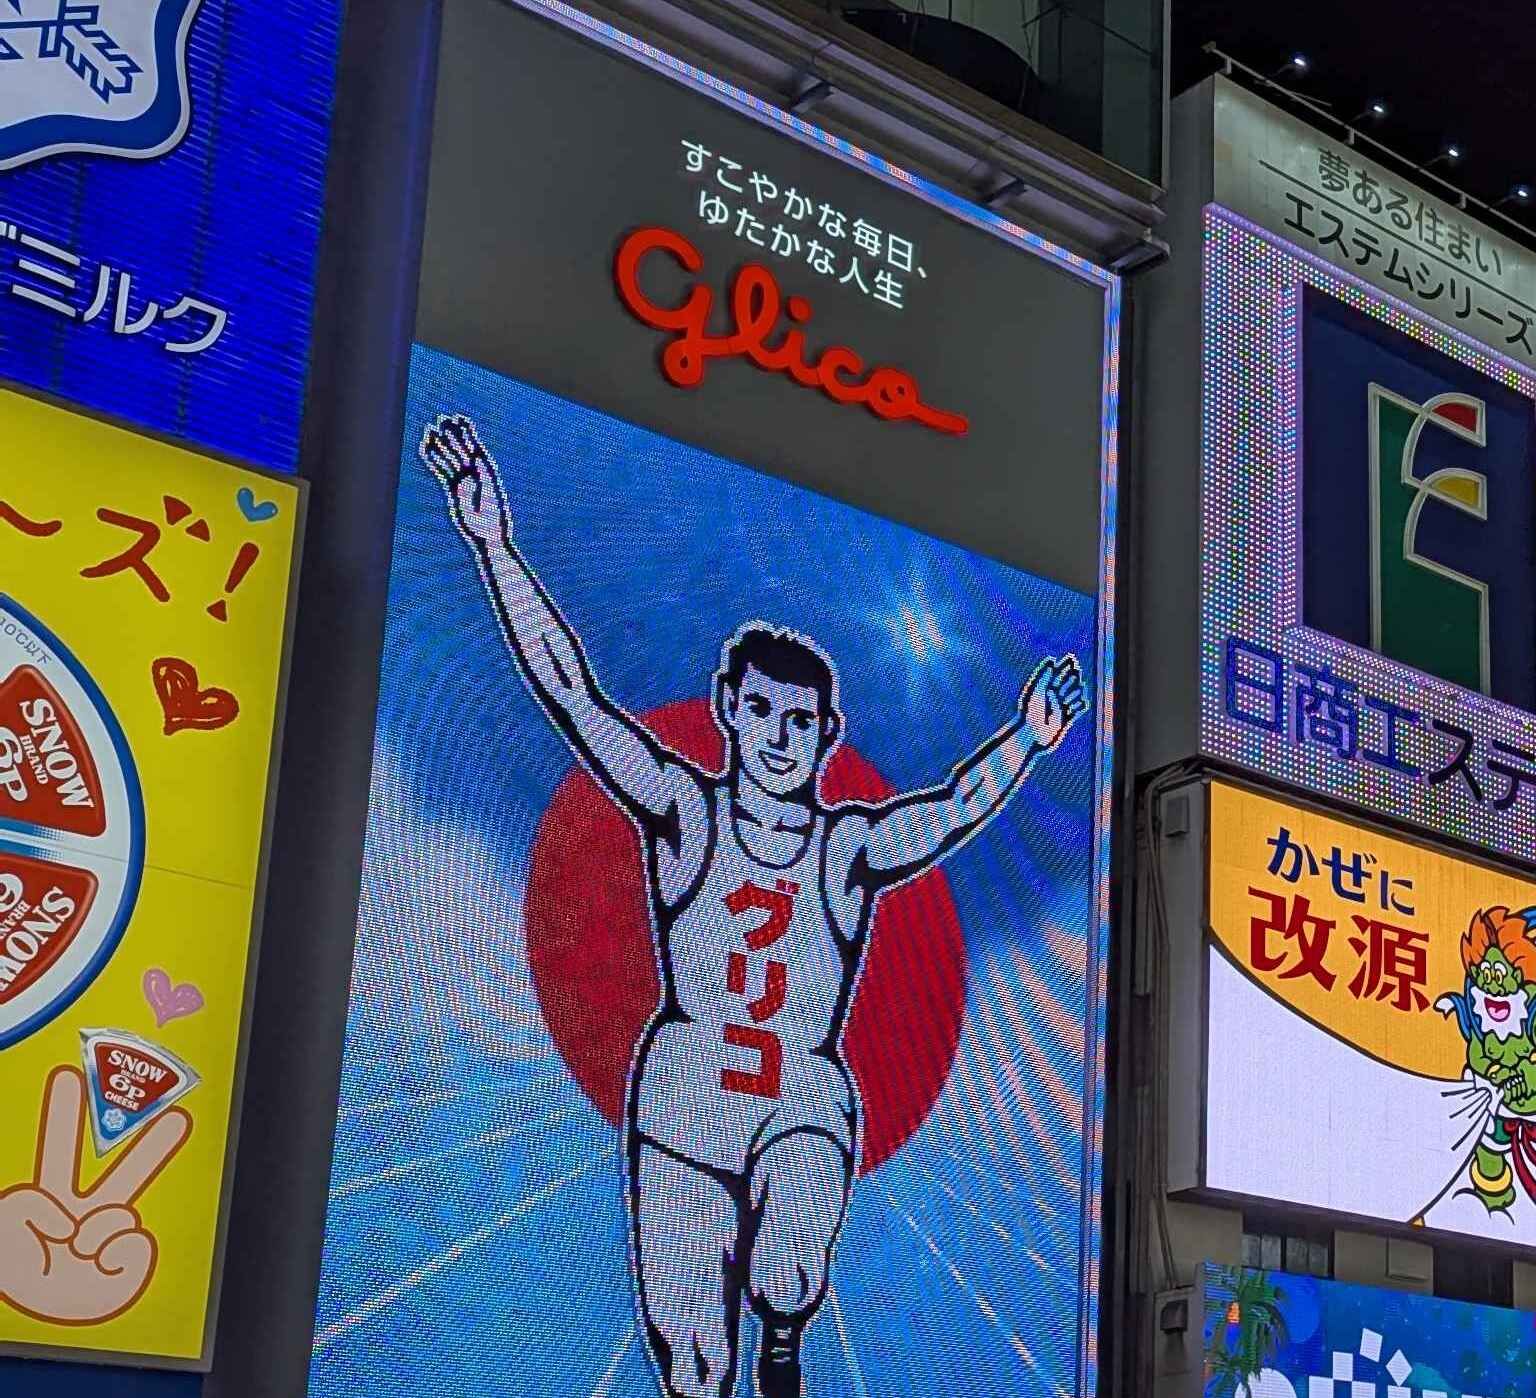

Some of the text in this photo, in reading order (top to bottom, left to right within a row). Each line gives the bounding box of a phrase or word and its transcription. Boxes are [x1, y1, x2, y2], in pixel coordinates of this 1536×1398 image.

[681, 140, 927, 278] すこやかな毎日、
[699, 190, 904, 309] ゆたかな人生
[1318, 148, 1503, 275] 夢ある住まい
[0, 222, 228, 353] ミルク
[1284, 192, 1534, 355] エステムシリーズ
[19, 697, 95, 809] SNOW
[19, 734, 50, 785] BRAND
[1266, 826, 1416, 916] かぜに
[719, 878, 800, 1098] グリコ
[1247, 885, 1431, 1013] 改源
[104, 1091, 141, 1111] CHEESE
[107, 1049, 168, 1083] SNOW
[109, 1074, 145, 1101] 6P
